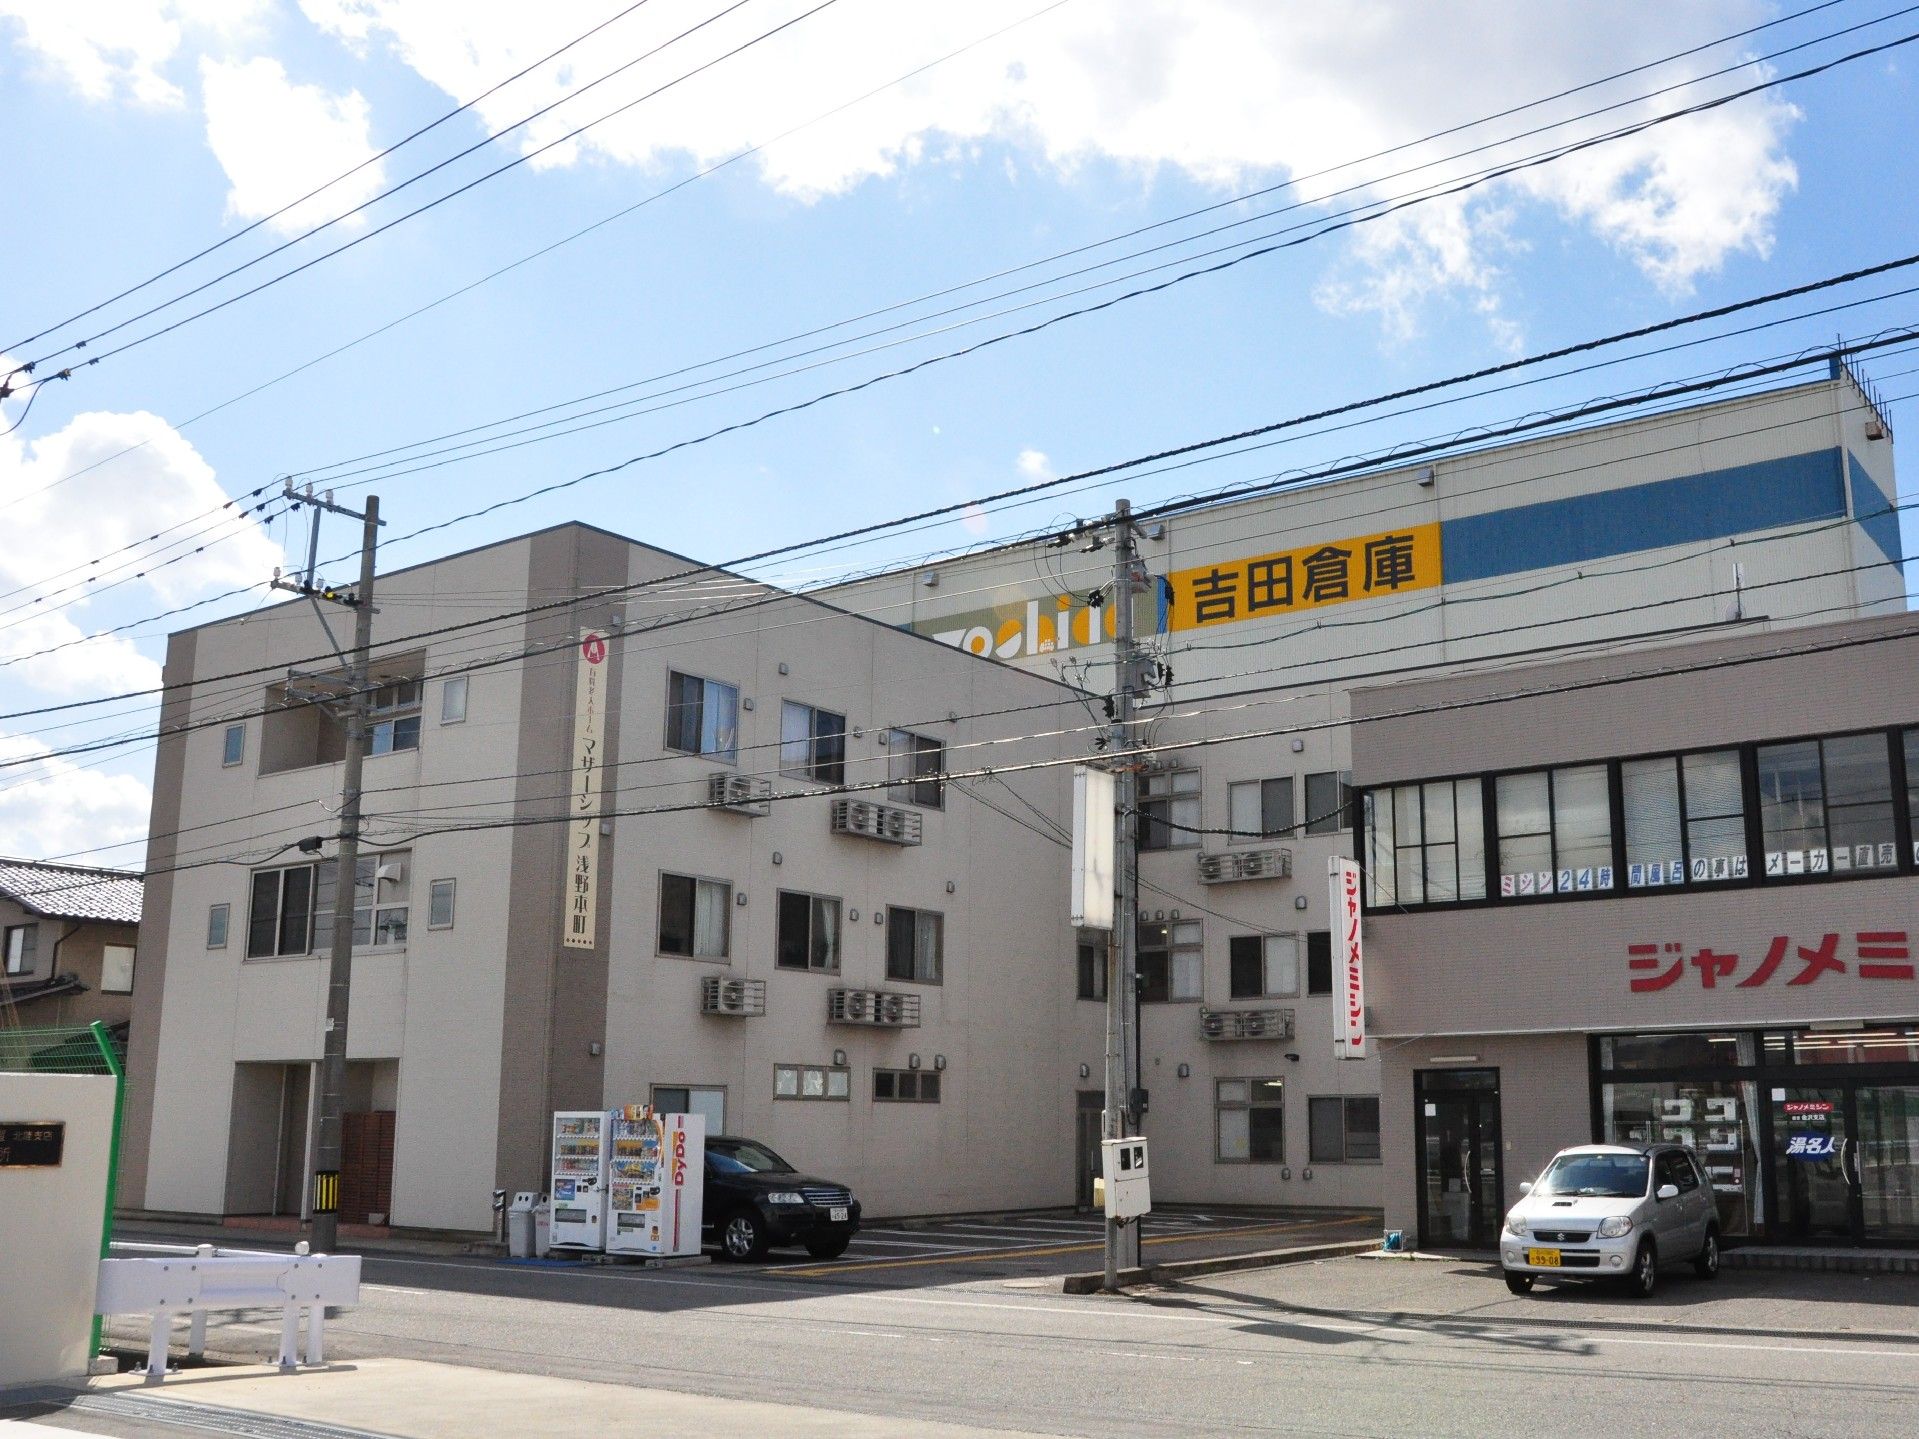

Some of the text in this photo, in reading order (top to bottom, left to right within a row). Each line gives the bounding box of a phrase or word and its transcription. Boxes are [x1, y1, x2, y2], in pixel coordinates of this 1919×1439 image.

[1193, 535, 1415, 623] 吉田倉庫
[572, 854, 590, 935] 浅野本町
[1345, 871, 1362, 1046] ジャノメミシン
[1628, 931, 1915, 992] ジャノメミ
[1786, 1103, 1830, 1111] ジャノメミシン
[674, 1131, 687, 1186] DyDo
[1785, 1136, 1836, 1155] 湯名人
